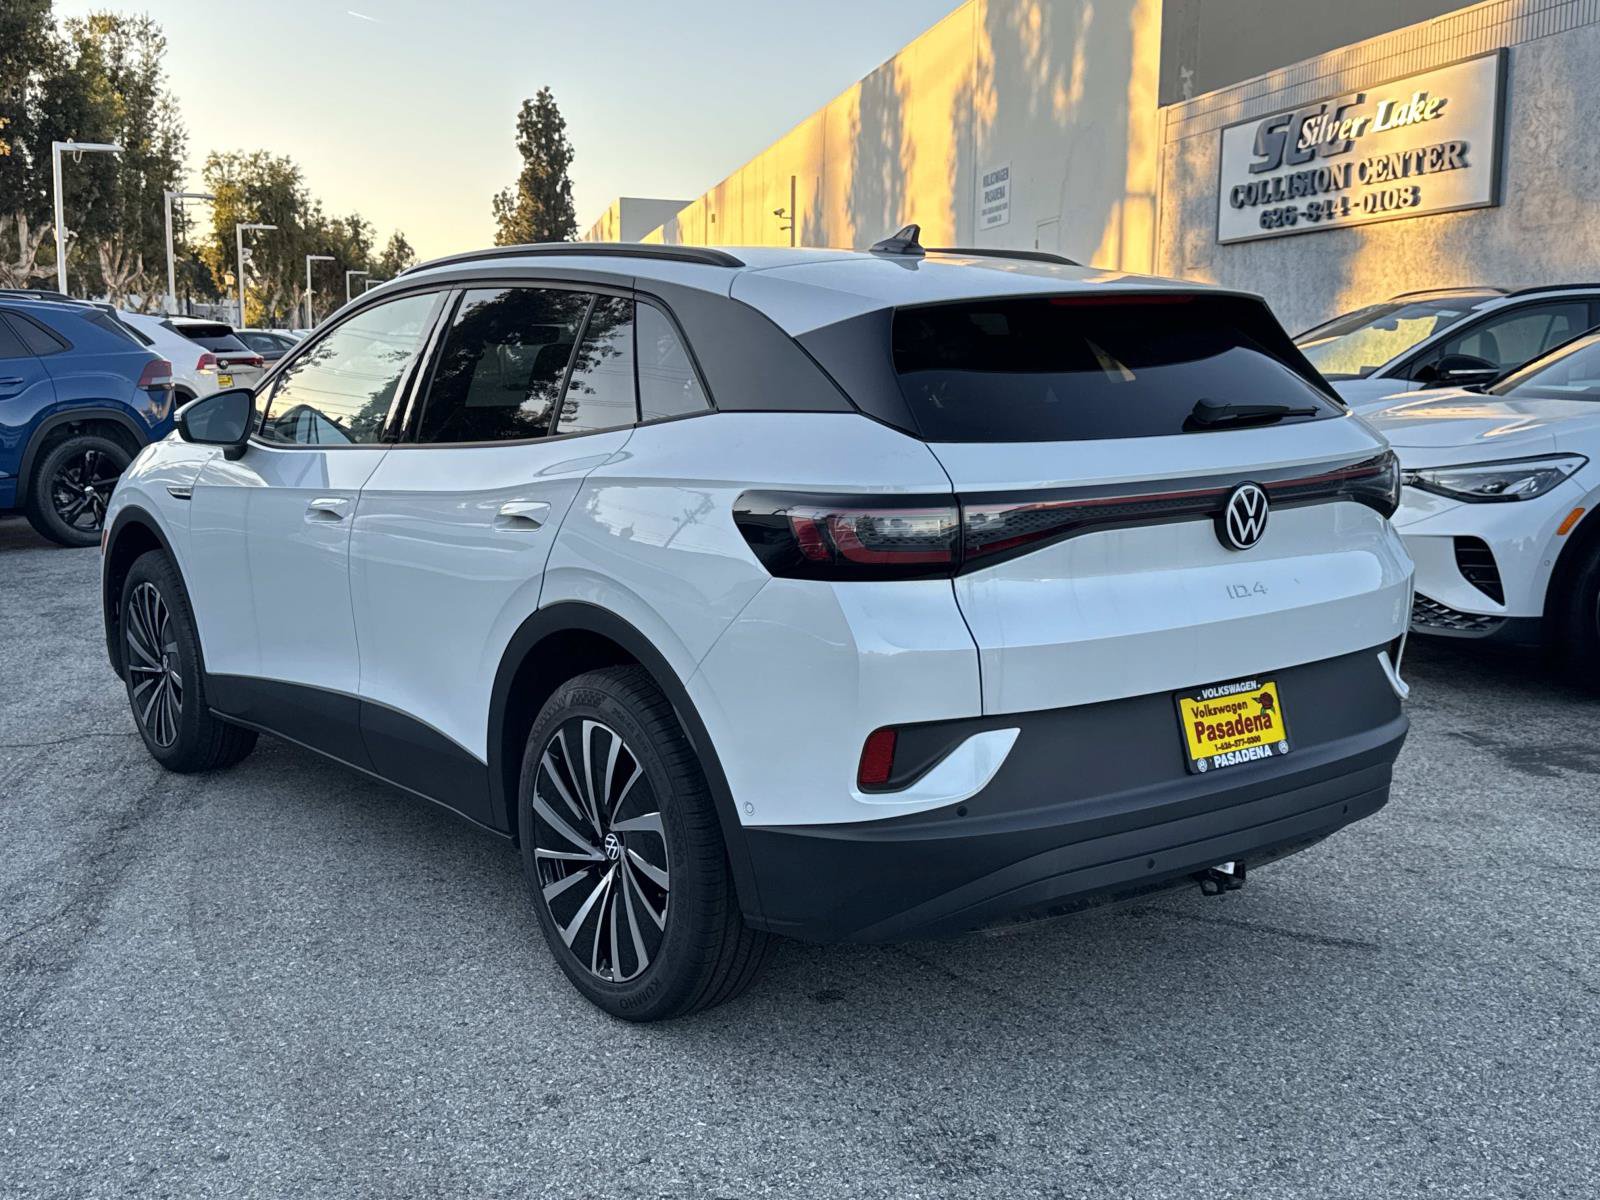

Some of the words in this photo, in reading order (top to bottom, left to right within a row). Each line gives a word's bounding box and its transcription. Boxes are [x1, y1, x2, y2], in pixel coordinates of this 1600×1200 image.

[1297, 113, 1369, 149] Silver
[1371, 90, 1446, 133] Lake
[1230, 162, 1353, 209] COLLISION
[1358, 140, 1471, 185] CENTER
[1259, 186, 1421, 229] 626-844-0108
[1201, 680, 1257, 700] VOLKSWAGEN
[1191, 701, 1248, 719] Volkswagen
[1194, 713, 1273, 744] Pasadena
[1213, 745, 1273, 768] PASADENA
[619, 977, 663, 1010] KUMHO
